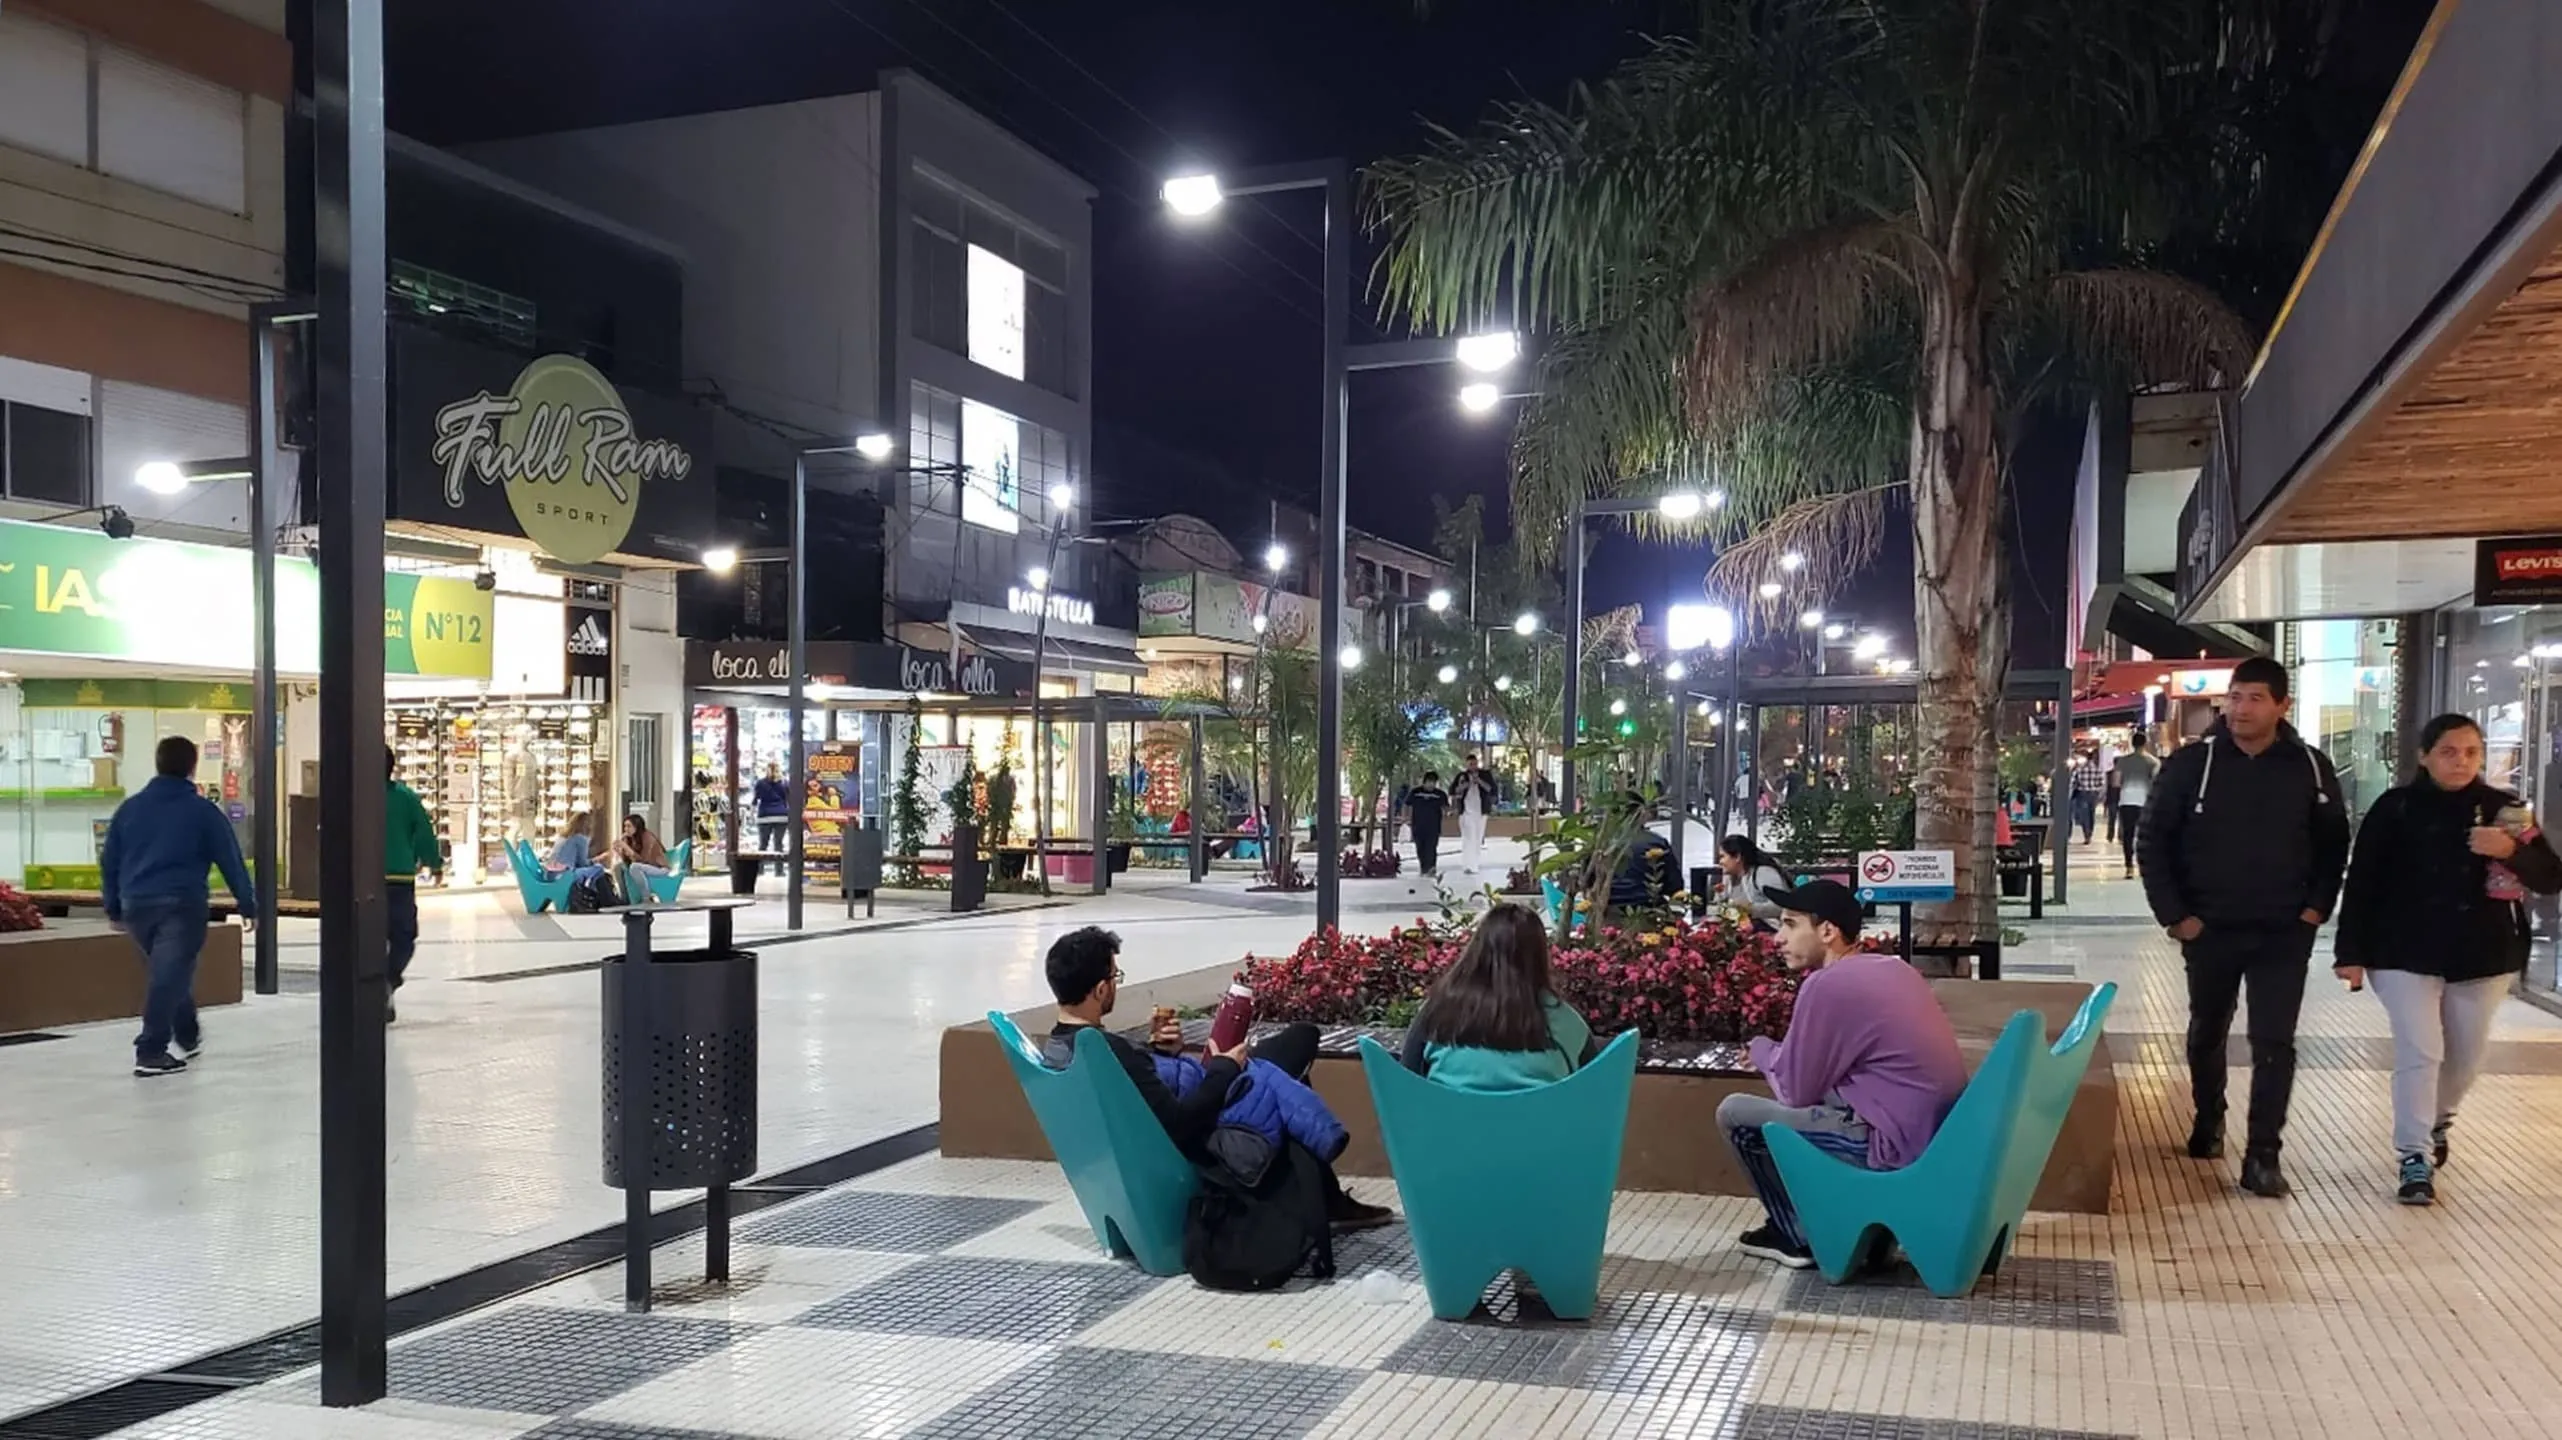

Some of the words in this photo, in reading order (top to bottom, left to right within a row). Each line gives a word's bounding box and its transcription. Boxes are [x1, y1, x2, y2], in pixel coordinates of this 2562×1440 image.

[434, 391, 572, 507] Full
[577, 407, 690, 504] Ram
[536, 501, 609, 526] SPORT
[711, 649, 763, 679] loca
[768, 649, 803, 679] ell
[900, 647, 946, 690] loca
[960, 655, 999, 695] ella
